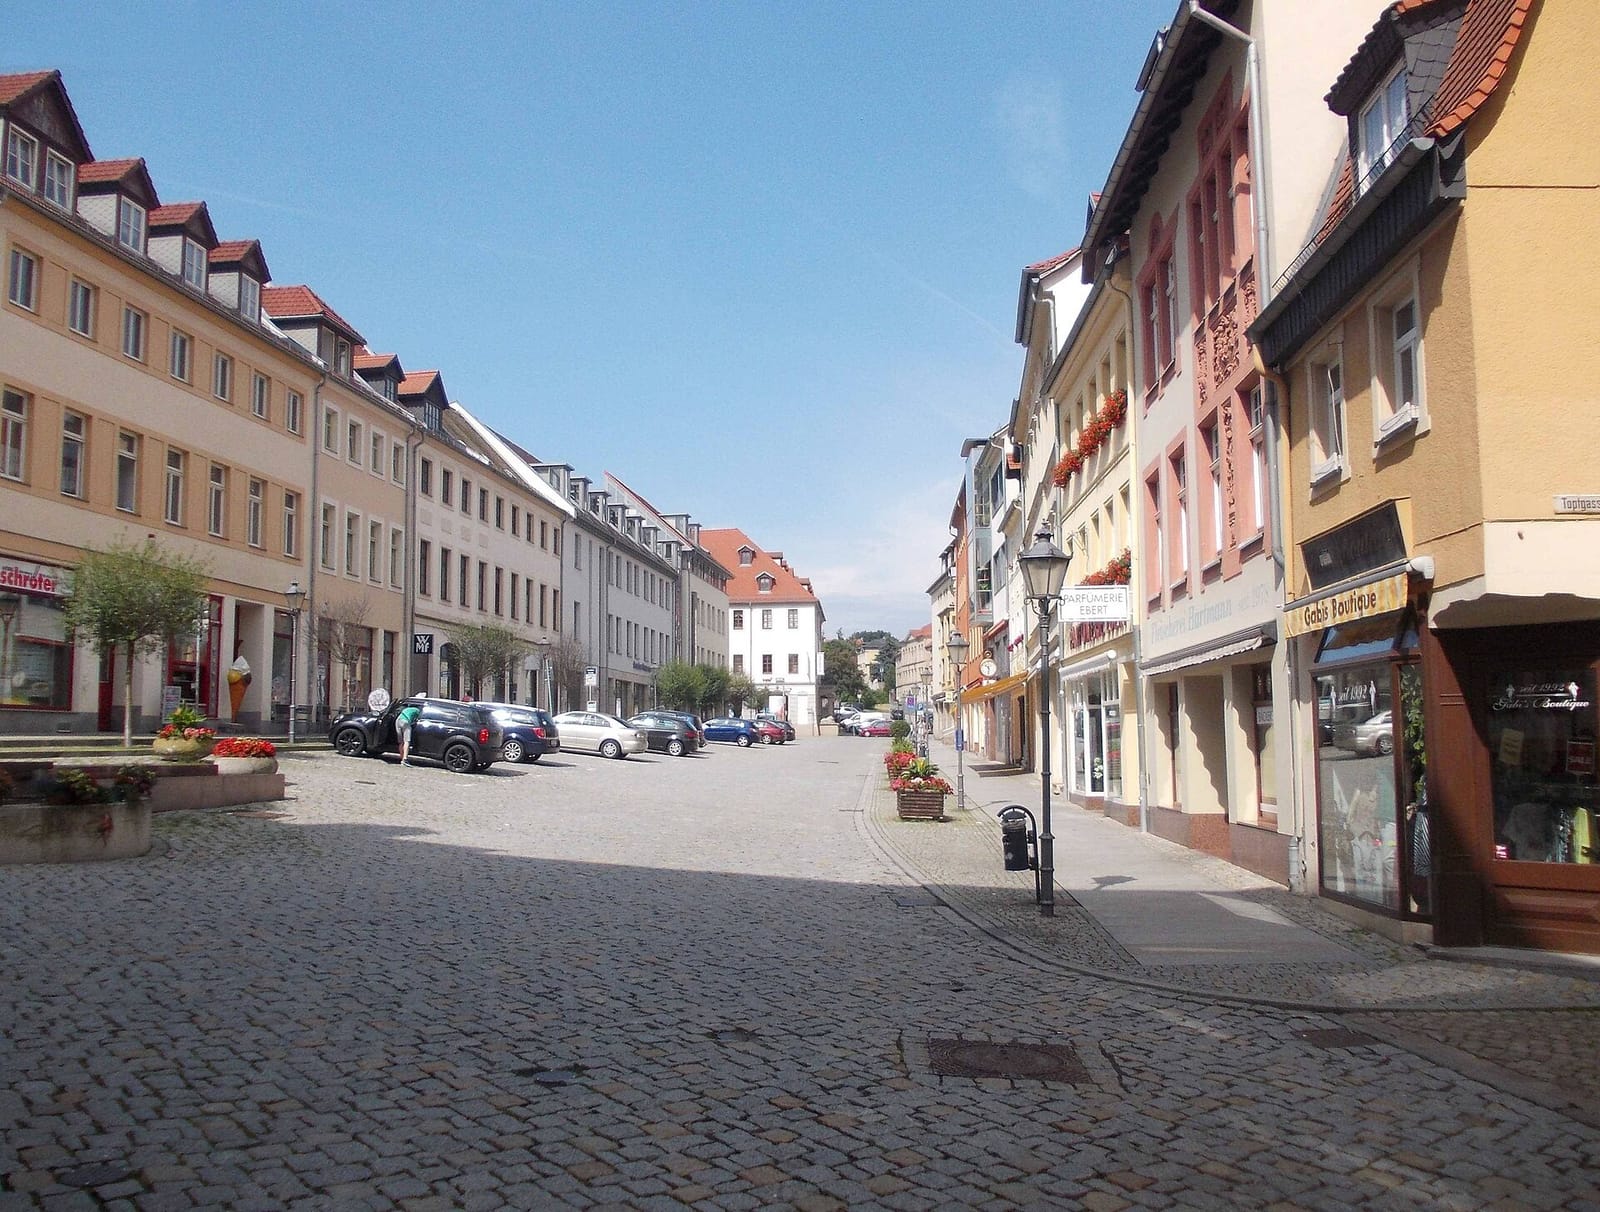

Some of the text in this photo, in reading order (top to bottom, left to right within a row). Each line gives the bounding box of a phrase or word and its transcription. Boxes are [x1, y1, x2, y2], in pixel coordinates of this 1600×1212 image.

[1063, 591, 1124, 604] PARFÜMERIE
[1079, 604, 1108, 616] EBERT
[1188, 599, 1233, 631] Hartmann
[1304, 590, 1377, 627] Gabis Boutique
[415, 635, 430, 653] WMF
[1533, 697, 1590, 712] Boutique
